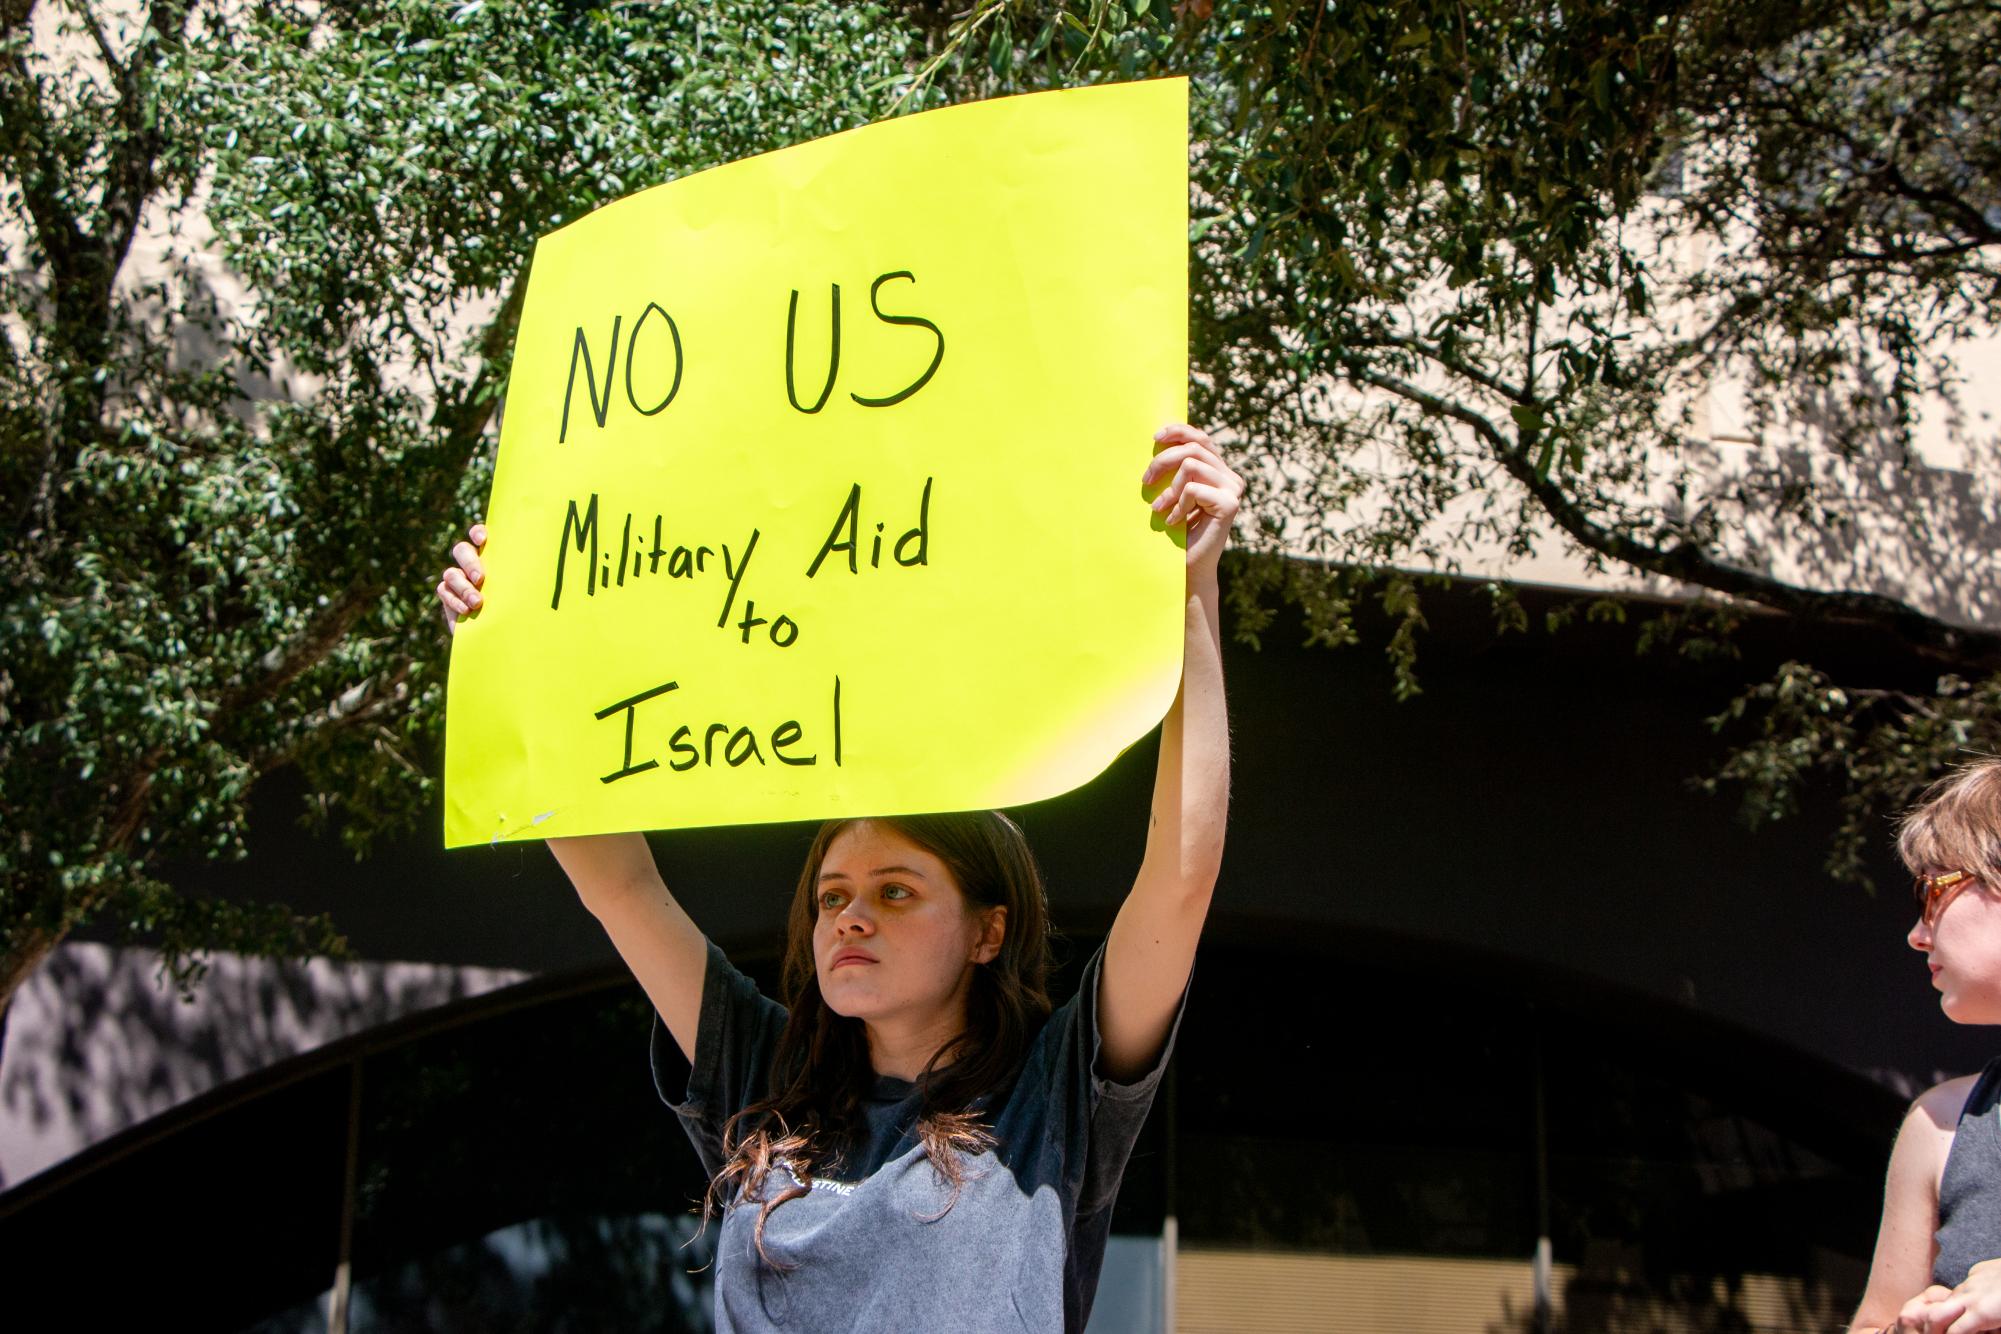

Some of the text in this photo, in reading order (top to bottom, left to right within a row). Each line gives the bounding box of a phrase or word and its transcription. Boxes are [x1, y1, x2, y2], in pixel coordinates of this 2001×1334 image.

[560, 271, 944, 443] NO US
[552, 477, 932, 628] Military Aid
[739, 601, 798, 647] to
[595, 676, 842, 783] Israel
